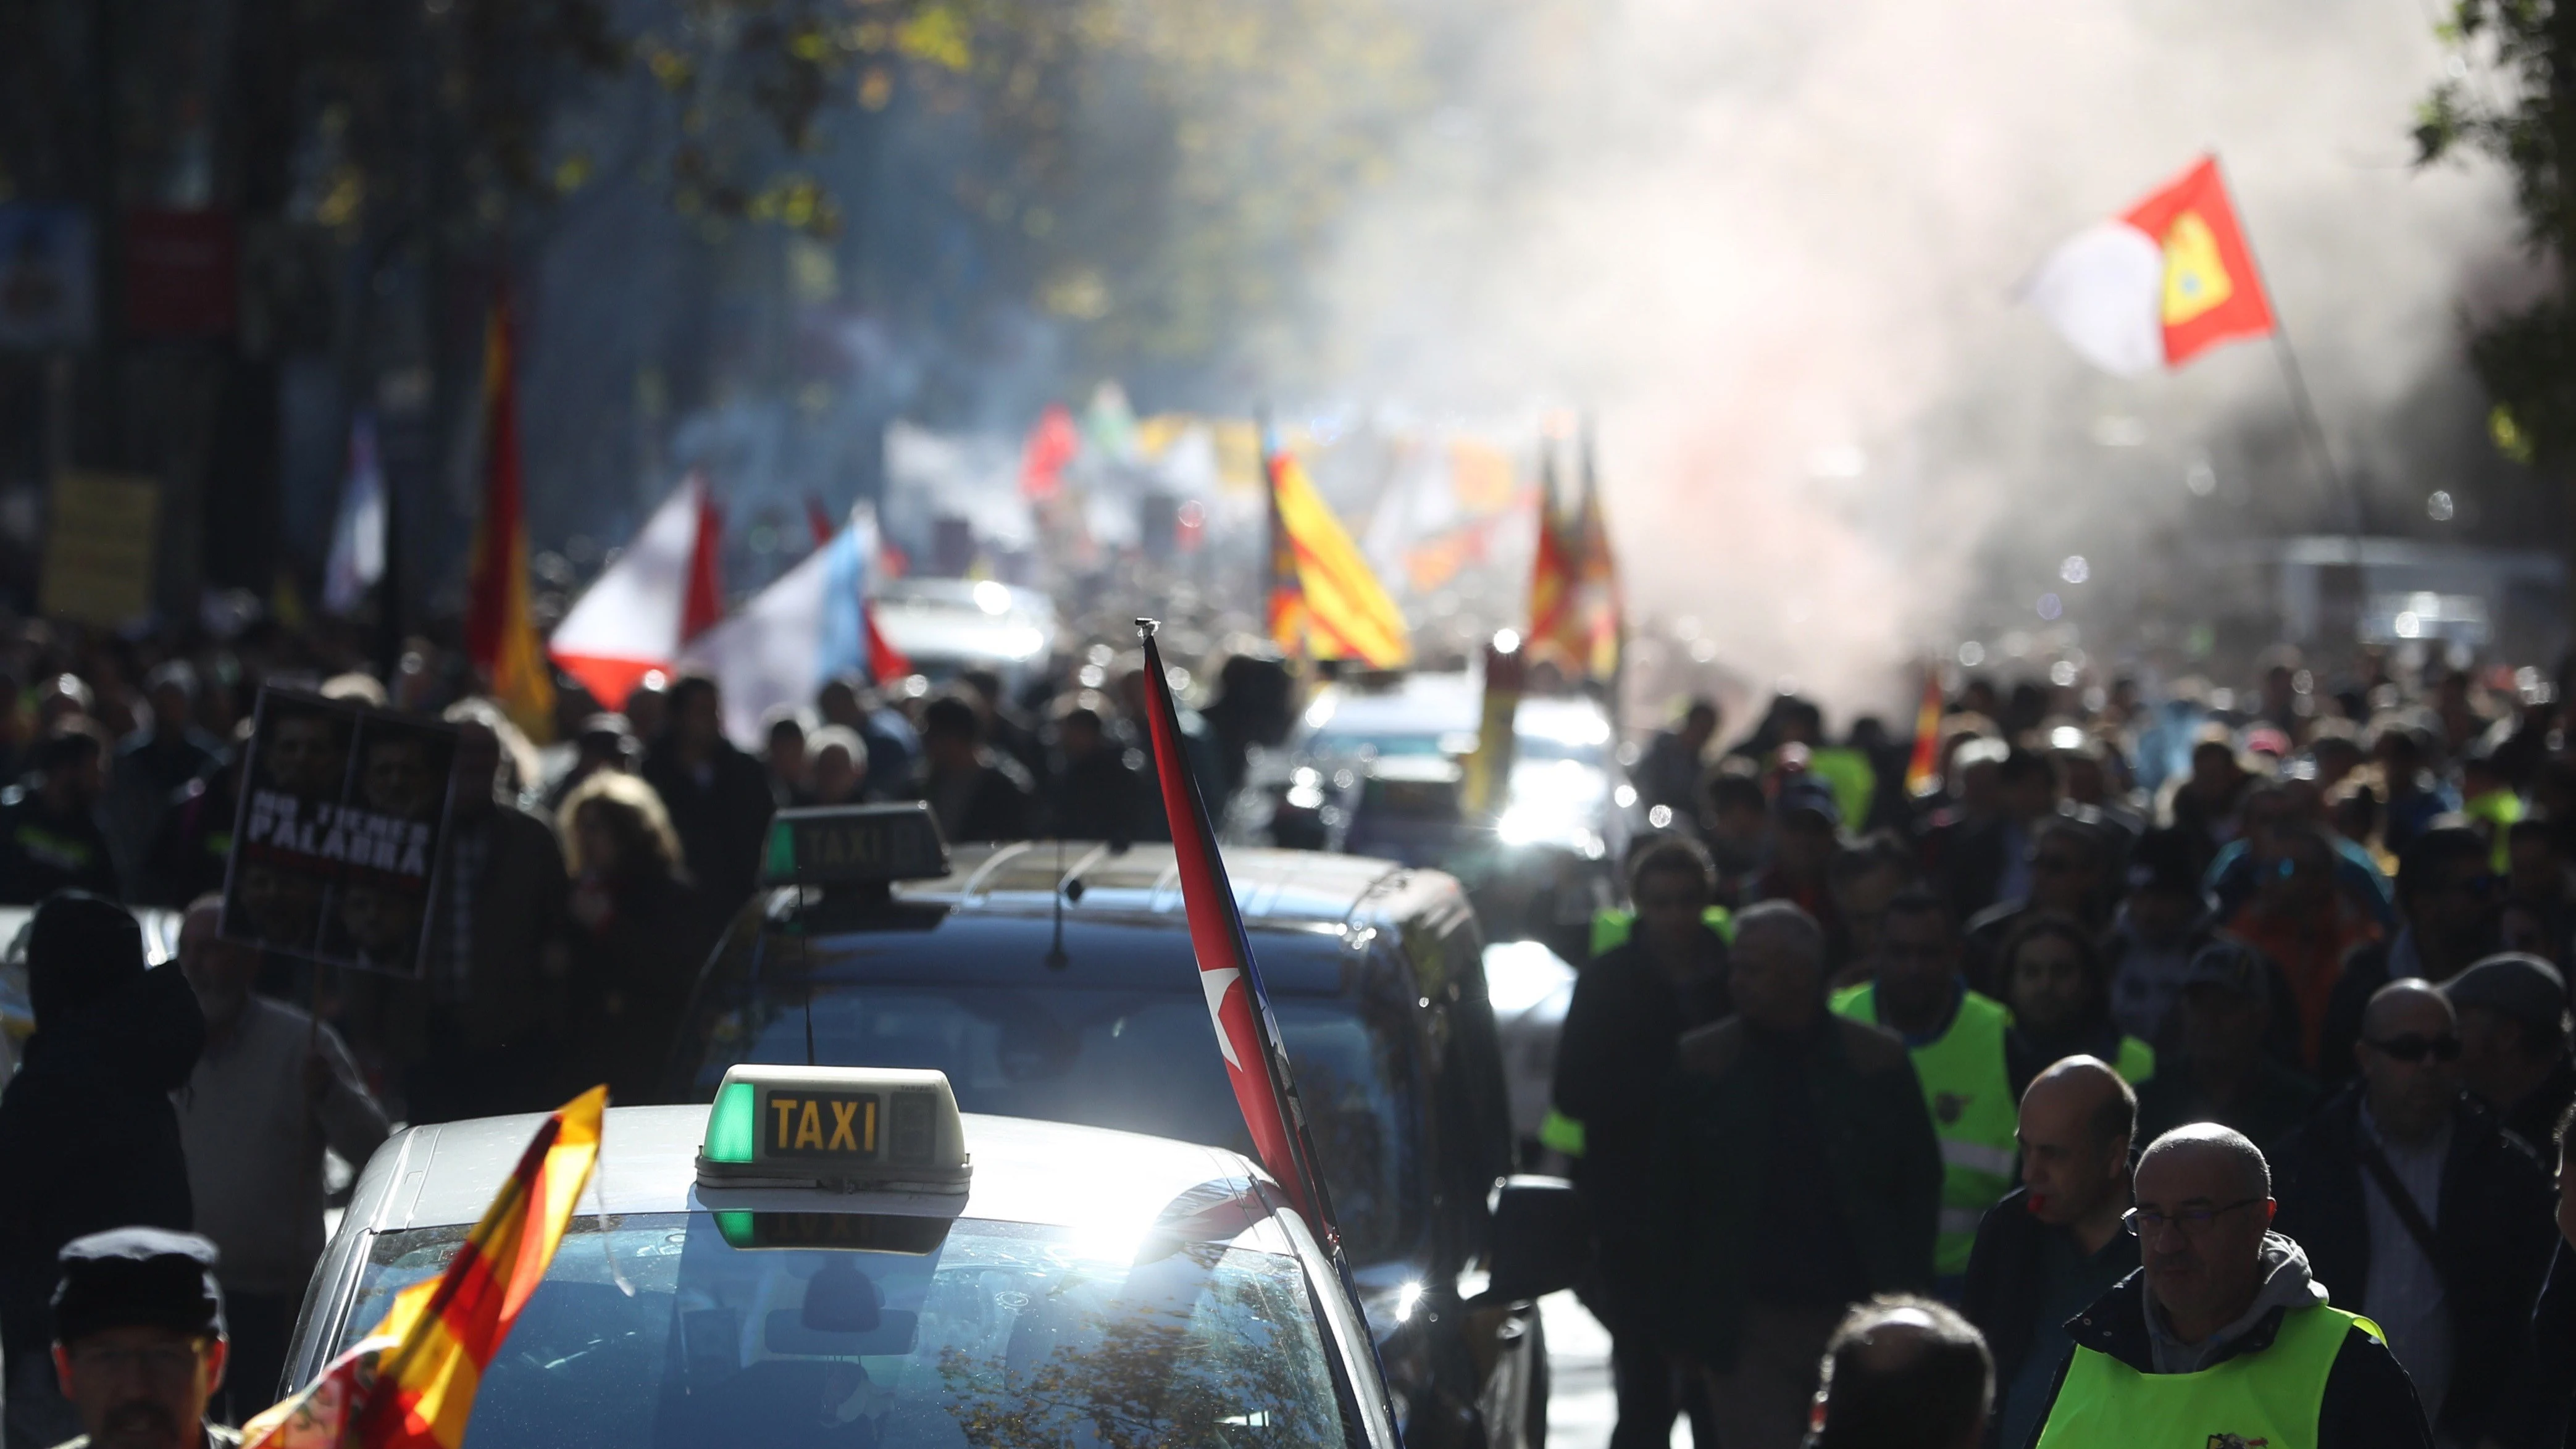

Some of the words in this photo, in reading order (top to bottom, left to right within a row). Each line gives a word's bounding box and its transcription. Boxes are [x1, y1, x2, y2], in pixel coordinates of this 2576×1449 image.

[253, 788, 298, 818] NO
[248, 814, 425, 877] PALABRA
[805, 828, 882, 865] TAXI
[771, 1098, 876, 1152] TAXI
